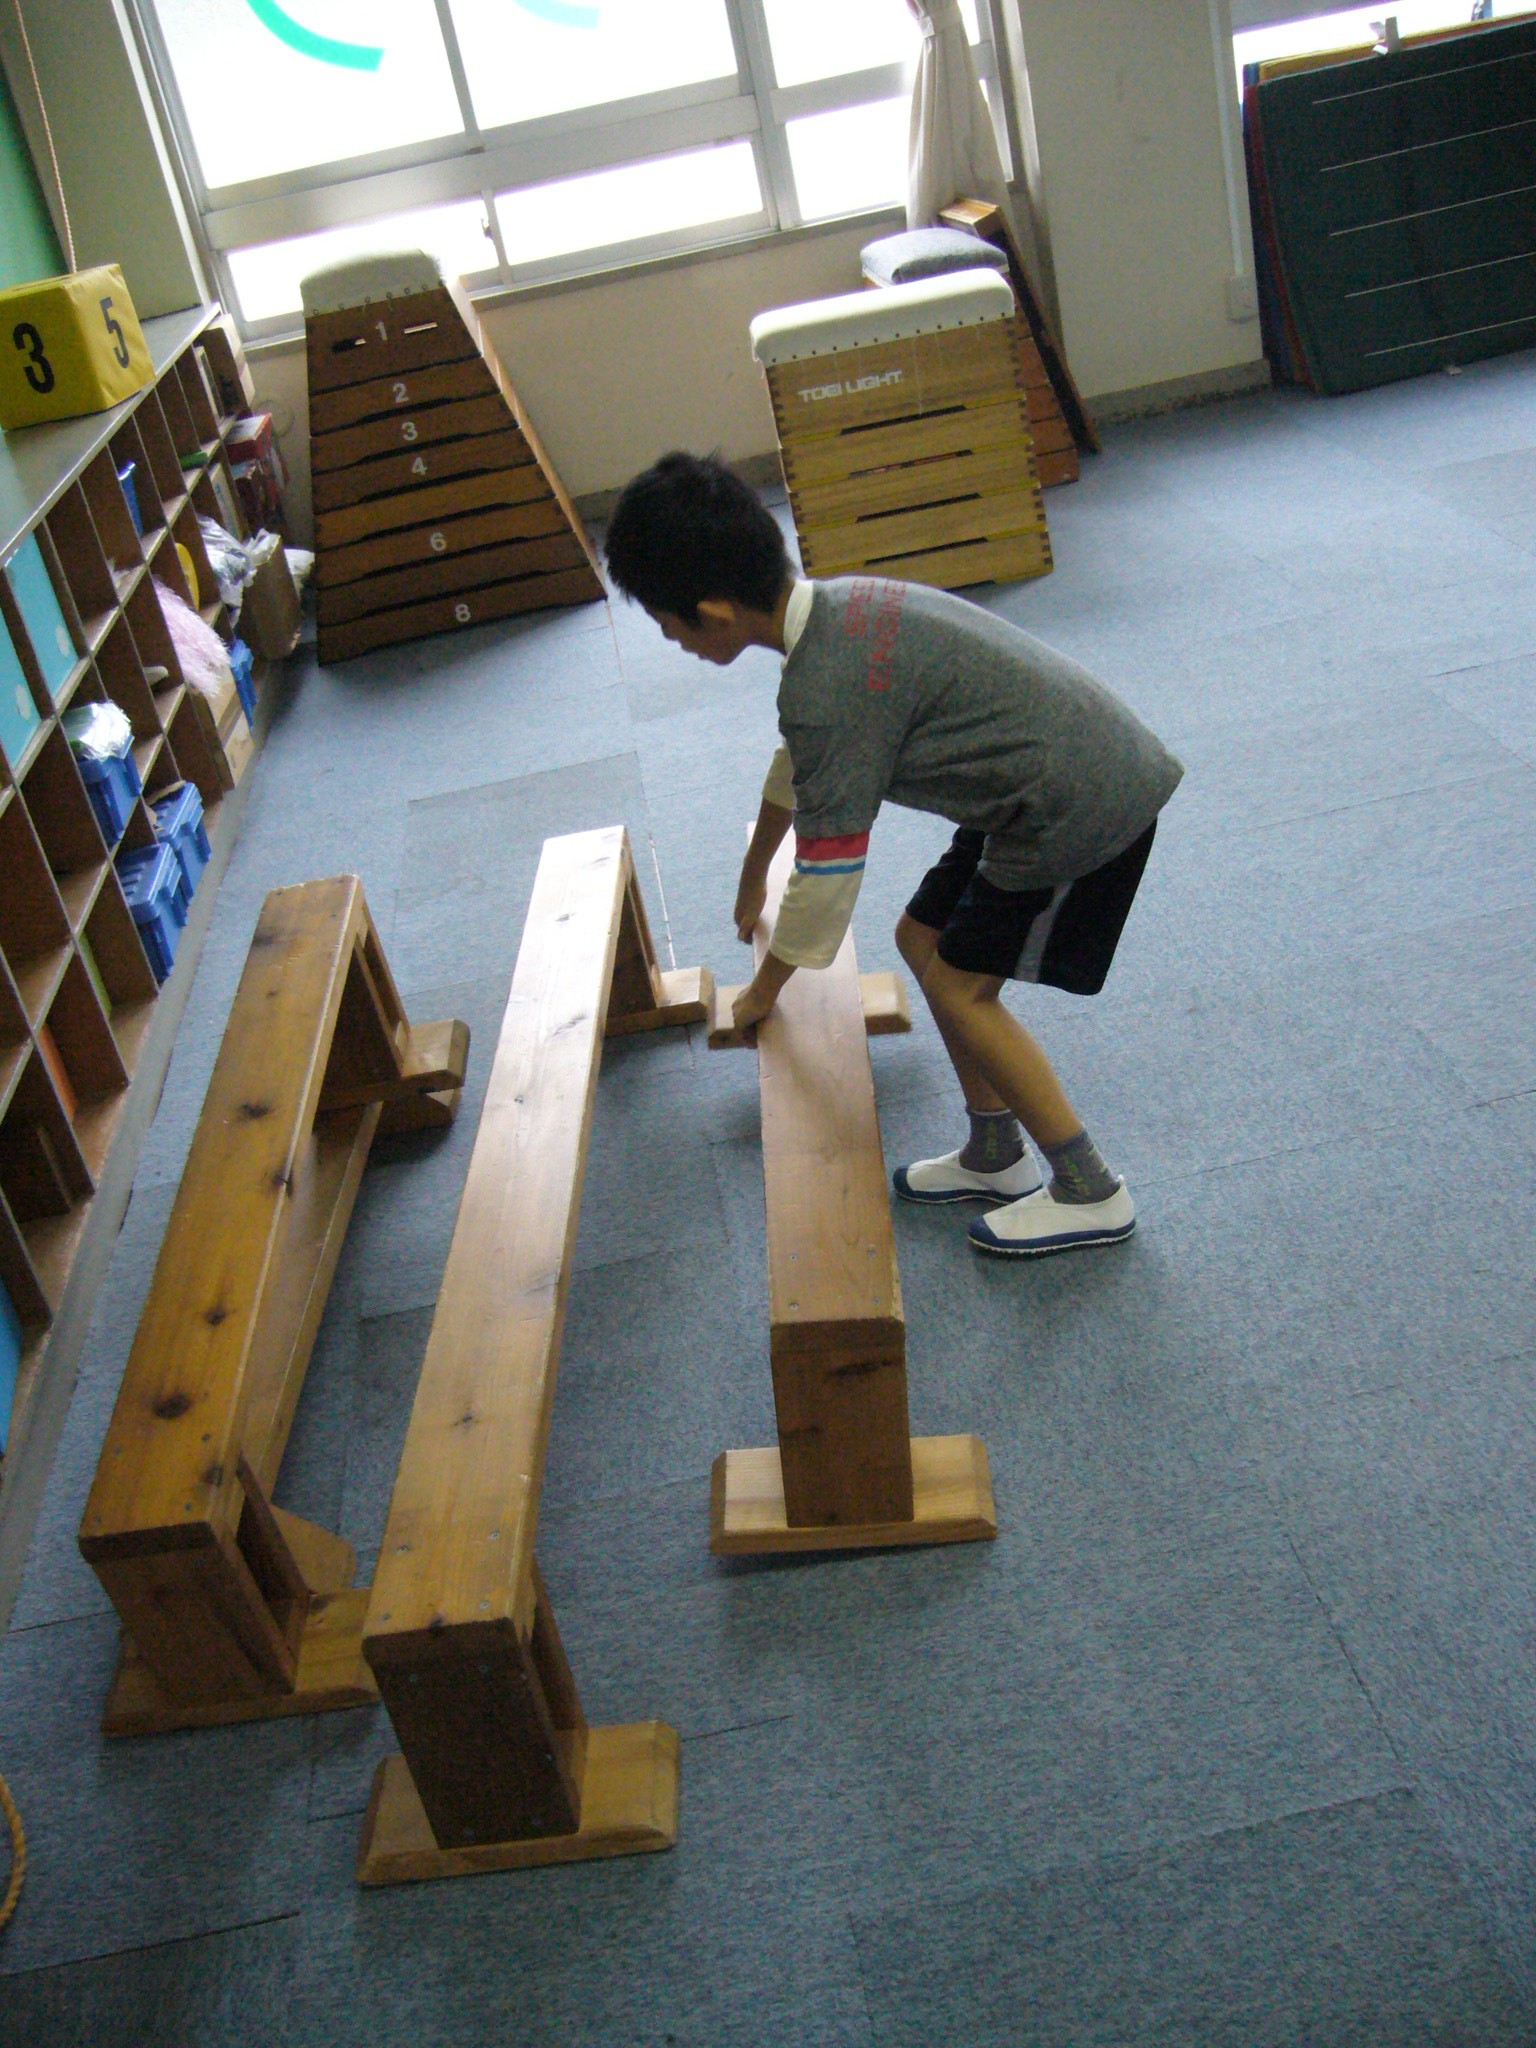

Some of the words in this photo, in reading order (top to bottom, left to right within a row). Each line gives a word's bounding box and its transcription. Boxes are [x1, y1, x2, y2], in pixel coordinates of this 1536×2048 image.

[99, 296, 130, 369] 5
[376, 320, 388, 341] 1
[13, 322, 55, 394] 3
[392, 382, 410, 403] 2
[845, 370, 903, 394] LIGHT
[401, 421, 419, 441] 3
[411, 456, 428, 476] 4
[430, 532, 447, 552] 6
[455, 603, 471, 622] 8
